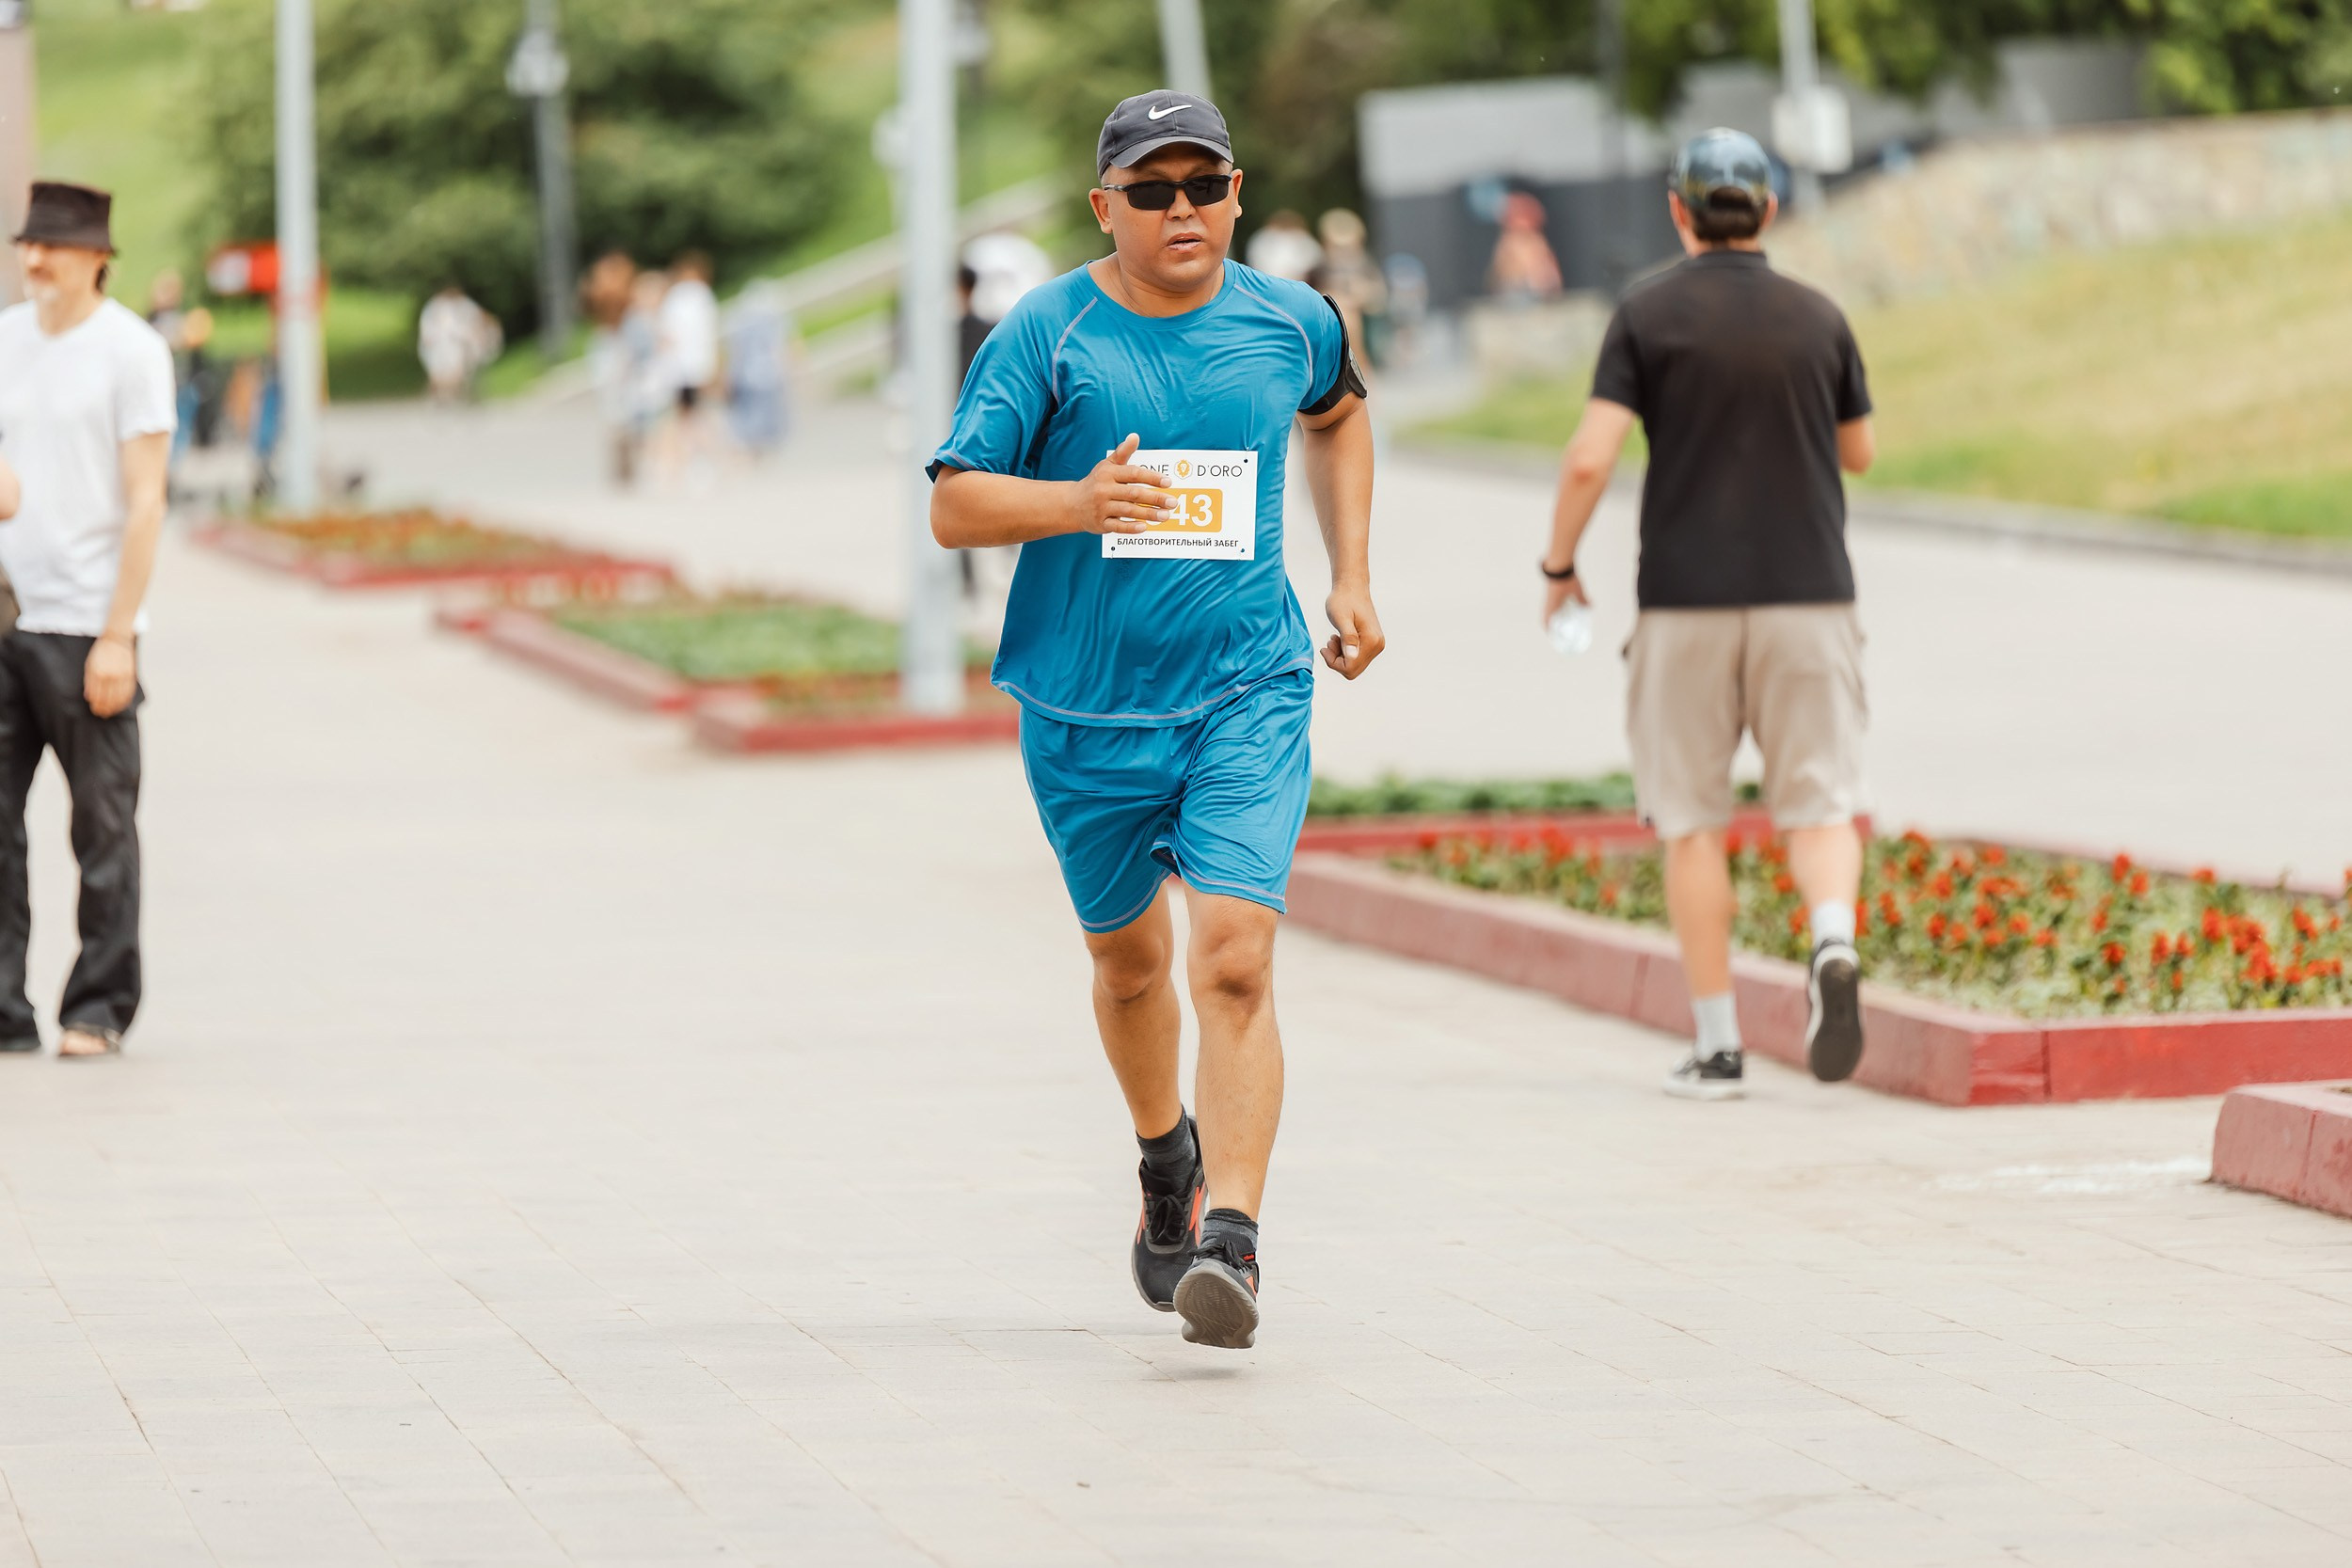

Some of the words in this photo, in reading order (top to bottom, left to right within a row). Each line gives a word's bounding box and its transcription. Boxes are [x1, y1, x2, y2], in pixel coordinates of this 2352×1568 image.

[1197, 465, 1243, 478] D'ORO
[1146, 494, 1214, 528] 43
[1117, 537, 1212, 546] БЛАГОТВОРИТЕЛЬНЫЙ
[1214, 539, 1239, 547] ЗАБЕГ
